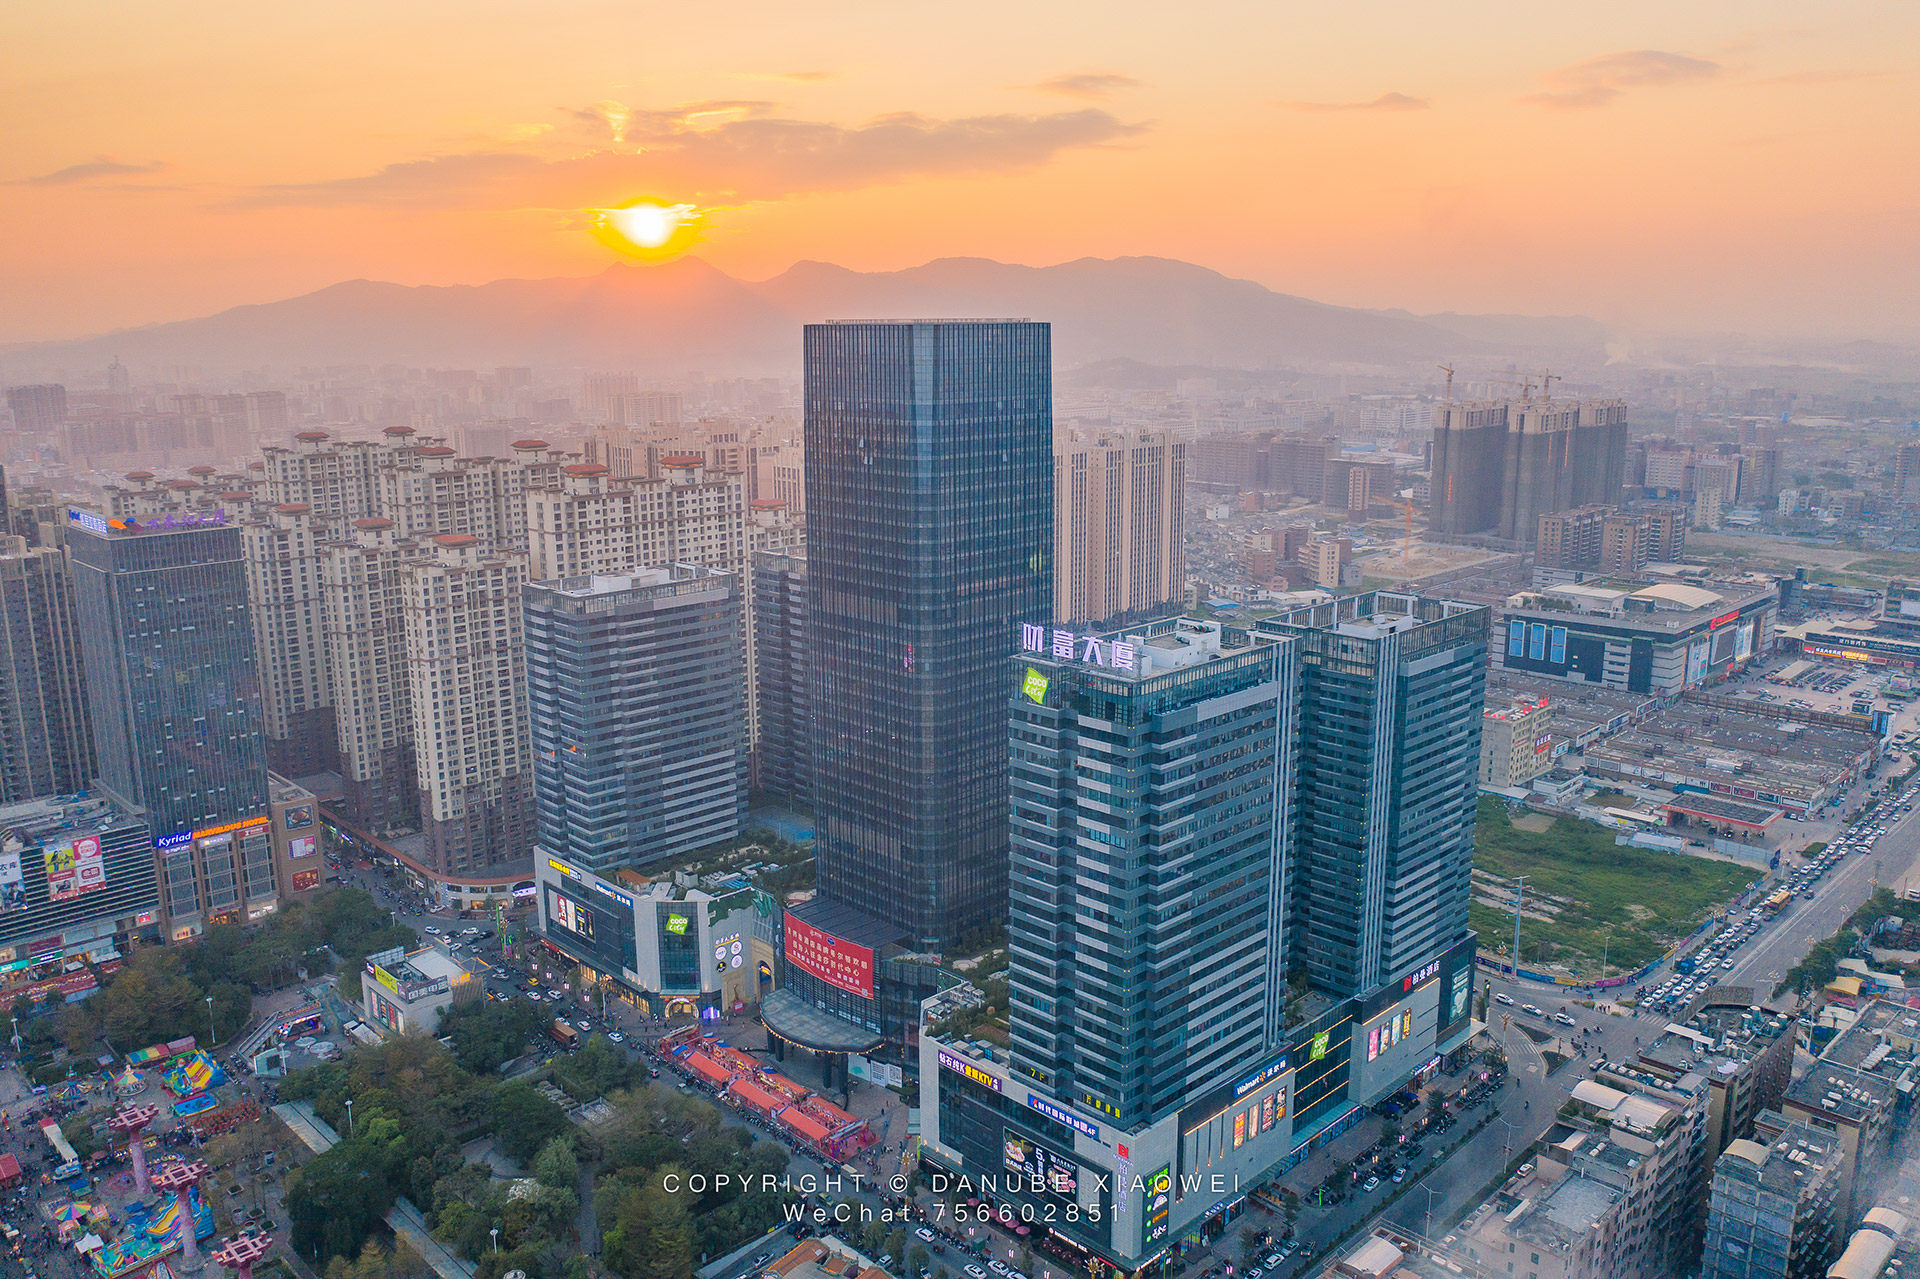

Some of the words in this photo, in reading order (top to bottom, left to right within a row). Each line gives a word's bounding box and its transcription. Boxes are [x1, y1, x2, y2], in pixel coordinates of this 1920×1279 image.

[1022, 623, 1135, 671] 财富大厦
[242, 816, 269, 828] HOTEL
[158, 831, 192, 847] Kyriad
[1237, 1076, 1260, 1095] Walmart
